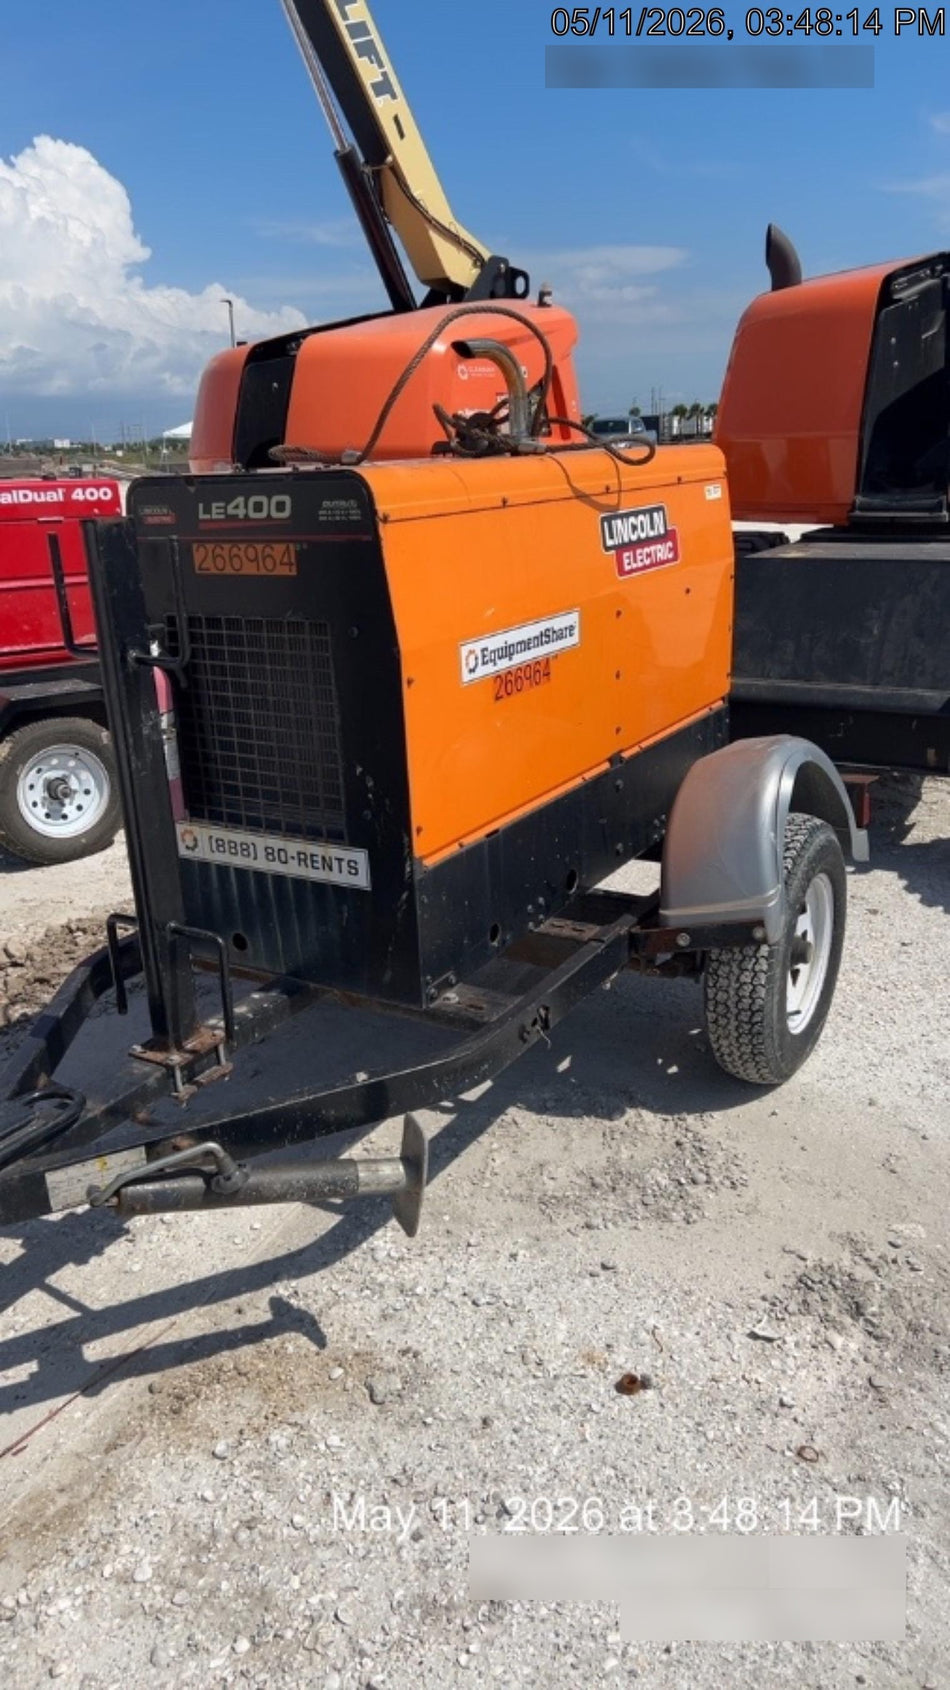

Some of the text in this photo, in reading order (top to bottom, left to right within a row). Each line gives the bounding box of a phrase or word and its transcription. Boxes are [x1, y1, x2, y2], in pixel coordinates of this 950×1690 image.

[336, 0, 399, 100] LIFT
[71, 487, 113, 501] 400
[198, 494, 292, 519] LE400
[602, 510, 666, 547] LINCOLN
[200, 543, 294, 573] 266964
[622, 541, 674, 572] ELECTRIC
[480, 620, 577, 667] EquipmentShare
[493, 659, 552, 702] 266964
[208, 835, 360, 877] (888) 80-RENTS
